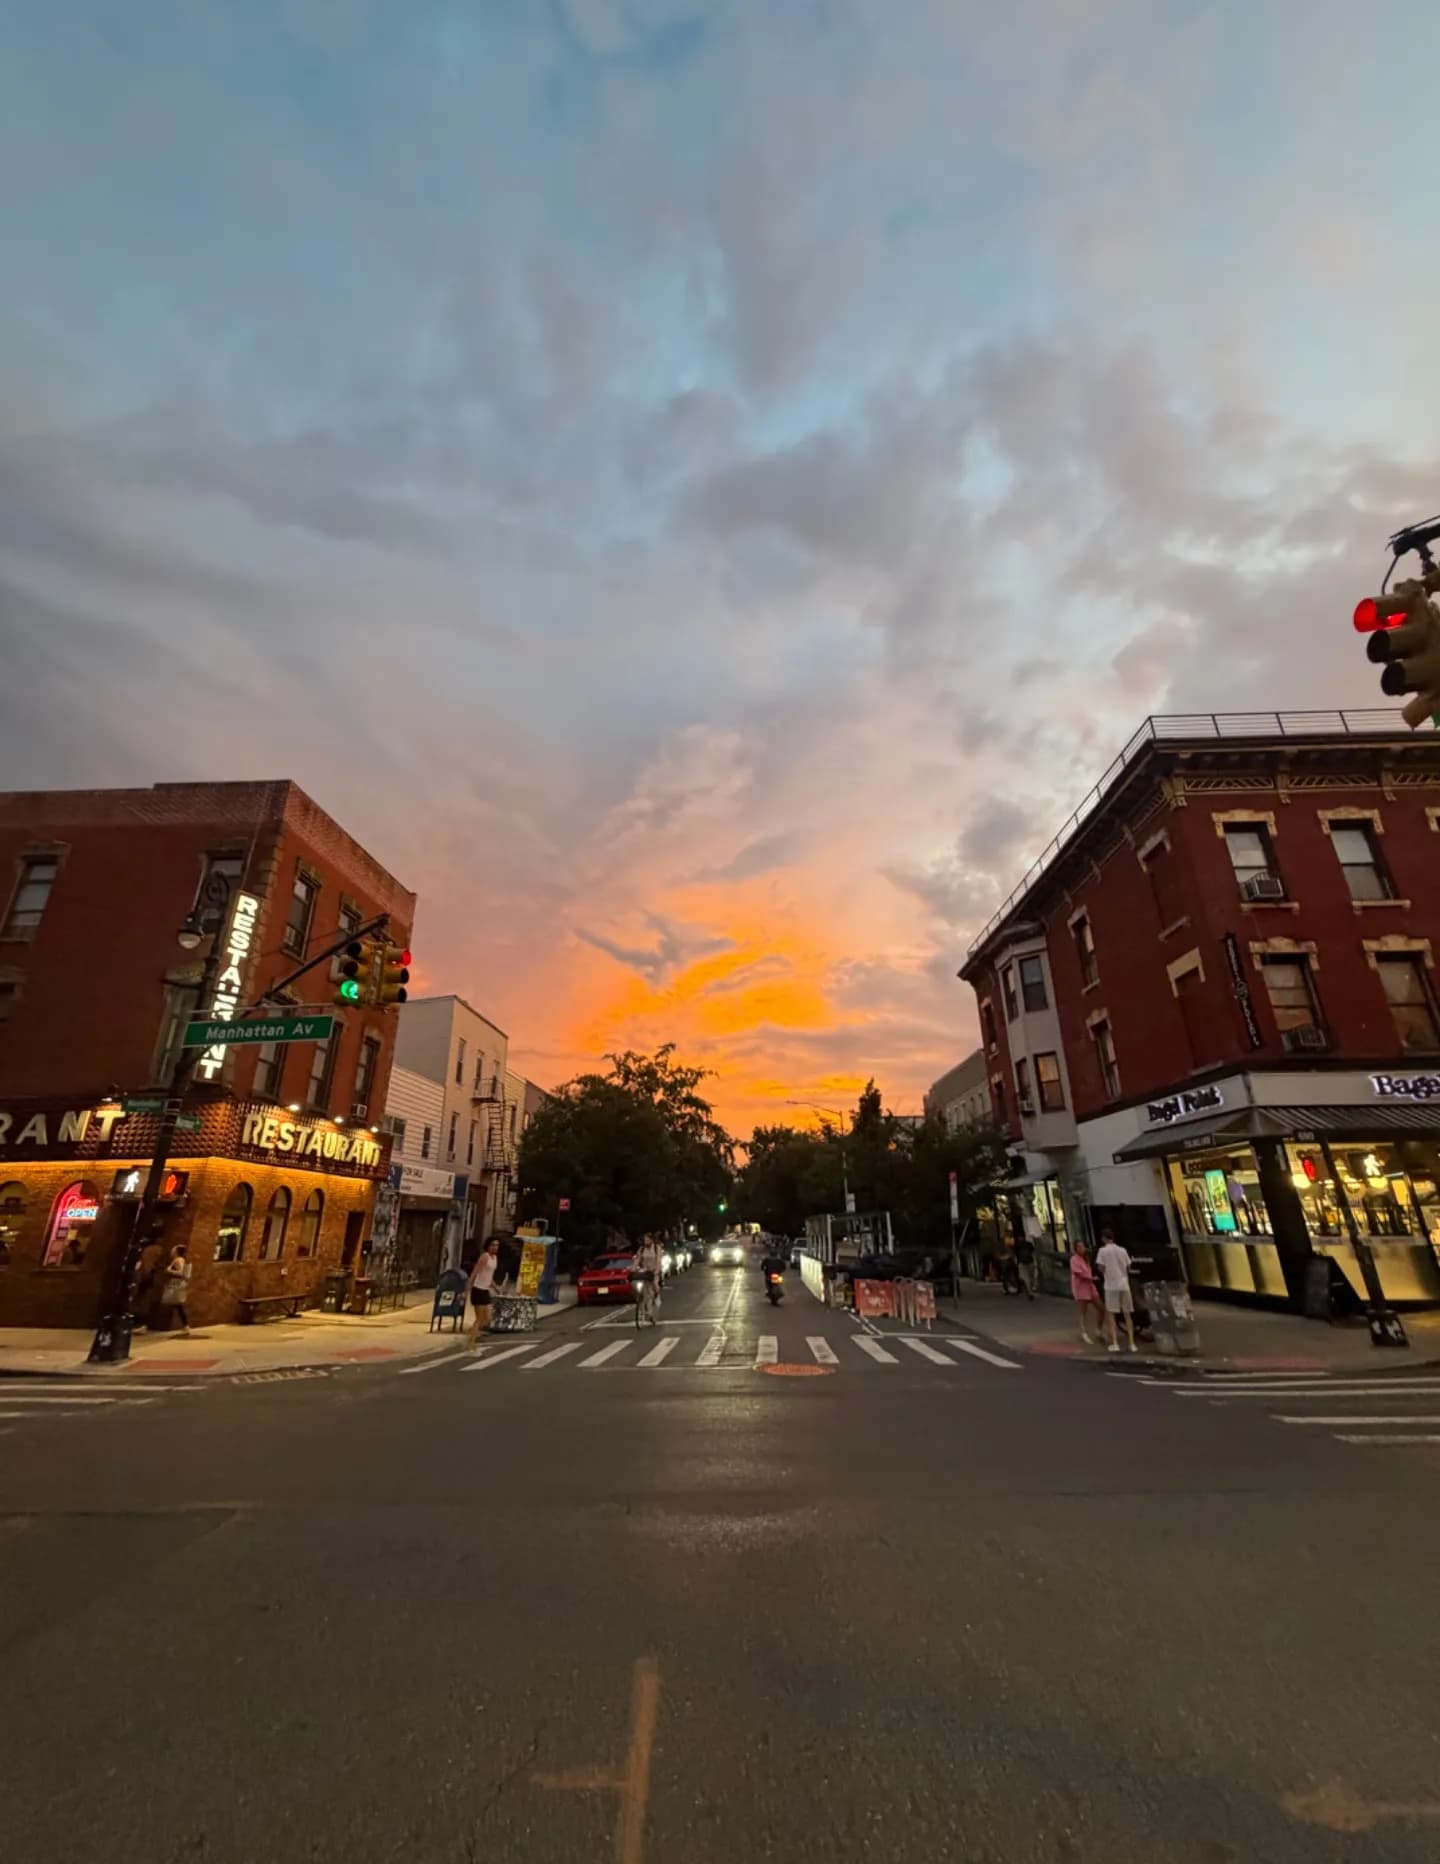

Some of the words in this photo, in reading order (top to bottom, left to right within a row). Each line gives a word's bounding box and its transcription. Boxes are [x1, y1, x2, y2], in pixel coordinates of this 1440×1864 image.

[200, 894, 258, 1079] RESTAURNT
[205, 1025, 285, 1040] Manhattan
[292, 1021, 315, 1036] Av
[1371, 1073, 1440, 1100] Bage
[242, 1112, 383, 1168] RESTAURANT
[67, 1207, 97, 1219] OPEN
